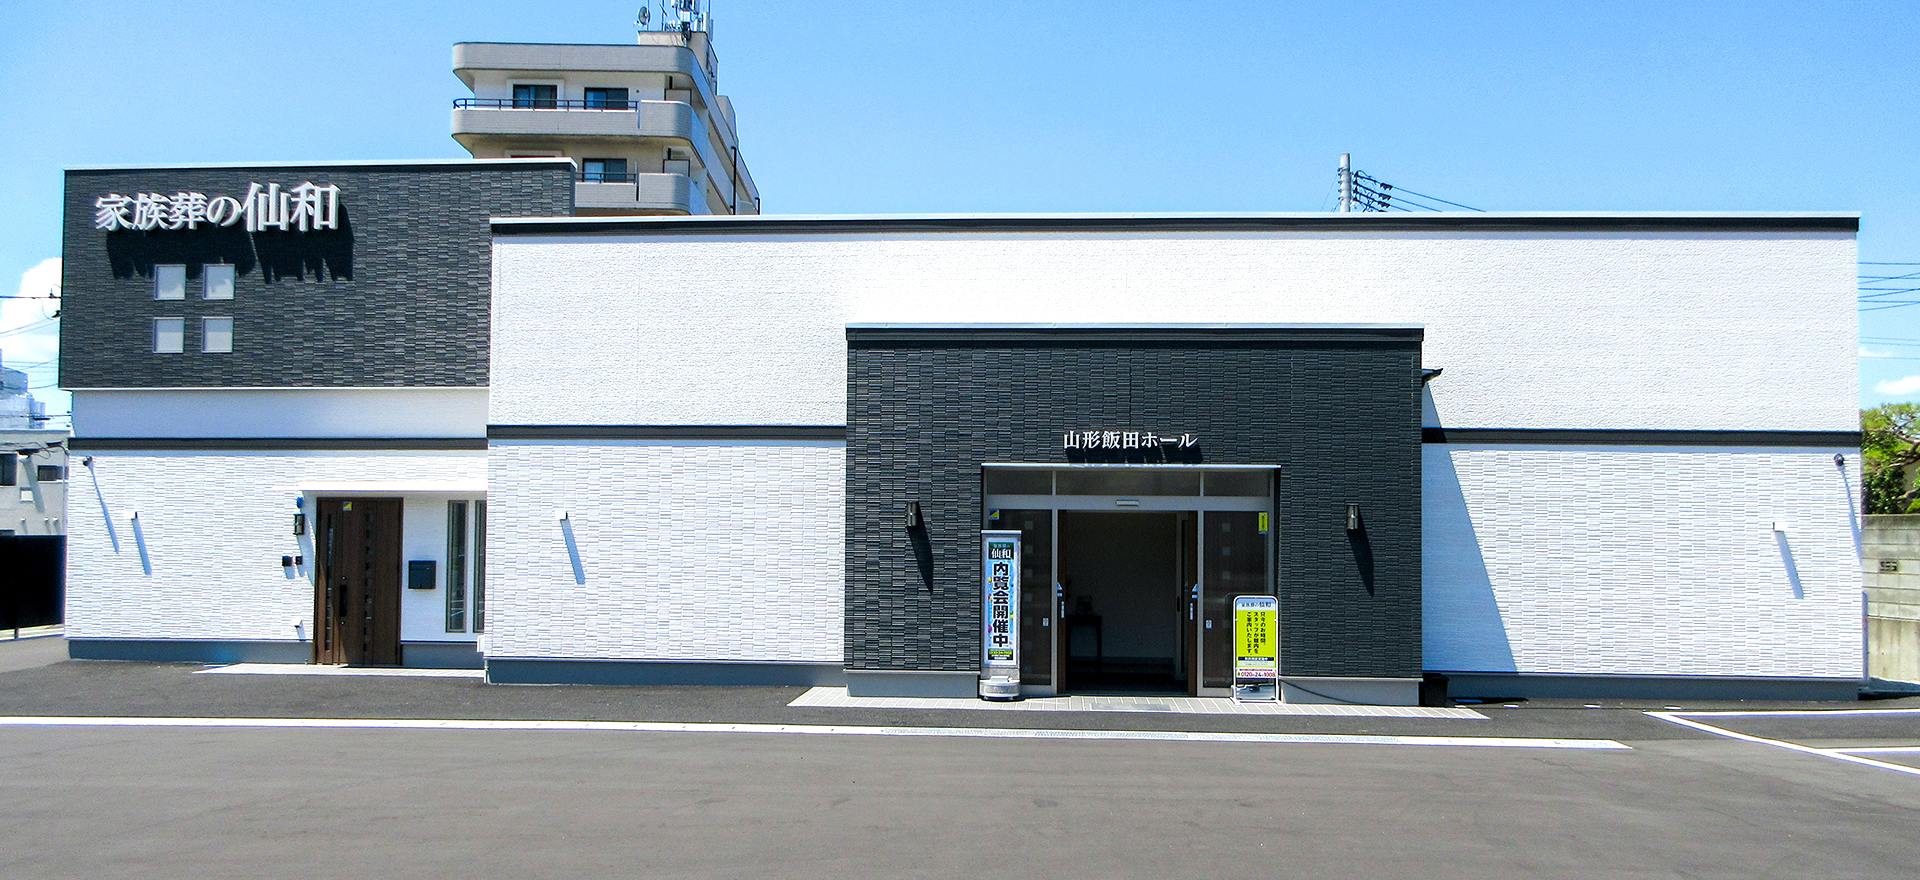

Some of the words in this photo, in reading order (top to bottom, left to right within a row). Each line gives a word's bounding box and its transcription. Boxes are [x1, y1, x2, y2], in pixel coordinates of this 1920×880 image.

[95, 181, 342, 233] 家族葬の仙和
[1063, 430, 1199, 449] 山形飯田ホール
[991, 548, 1012, 559] 仙和
[992, 562, 1010, 648] 内覧会開催中
